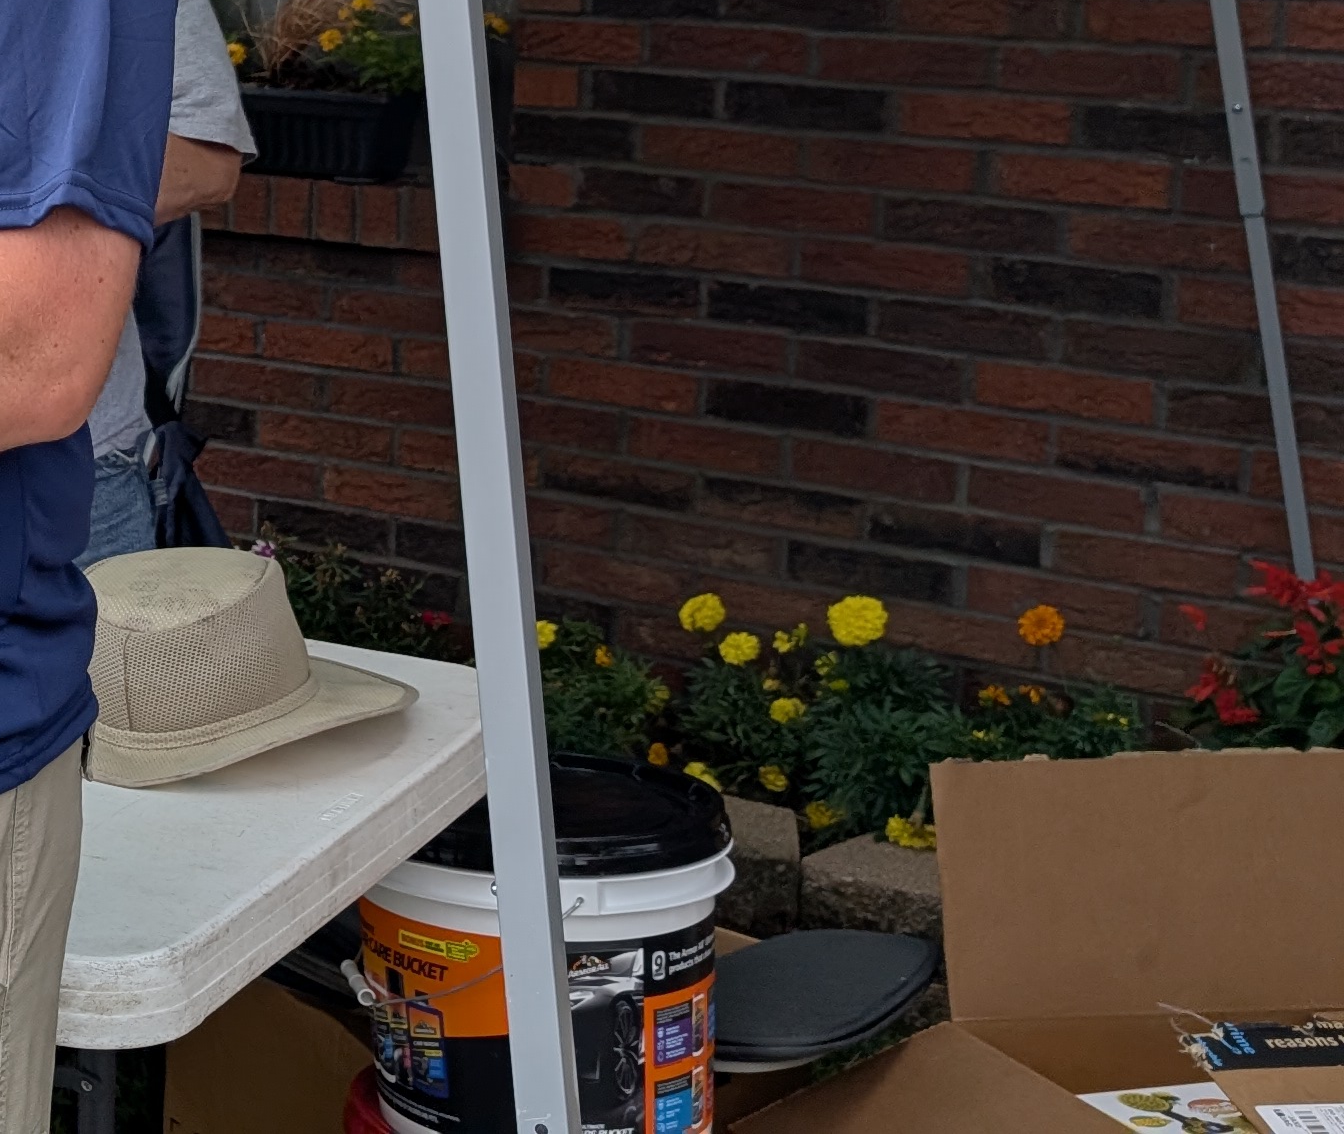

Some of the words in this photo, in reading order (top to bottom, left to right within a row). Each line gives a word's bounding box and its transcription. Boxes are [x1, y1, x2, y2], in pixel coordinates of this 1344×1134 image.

[393, 950, 450, 983] BUCKET
[654, 954, 663, 972] 9
[1264, 1036, 1339, 1049] reasons
